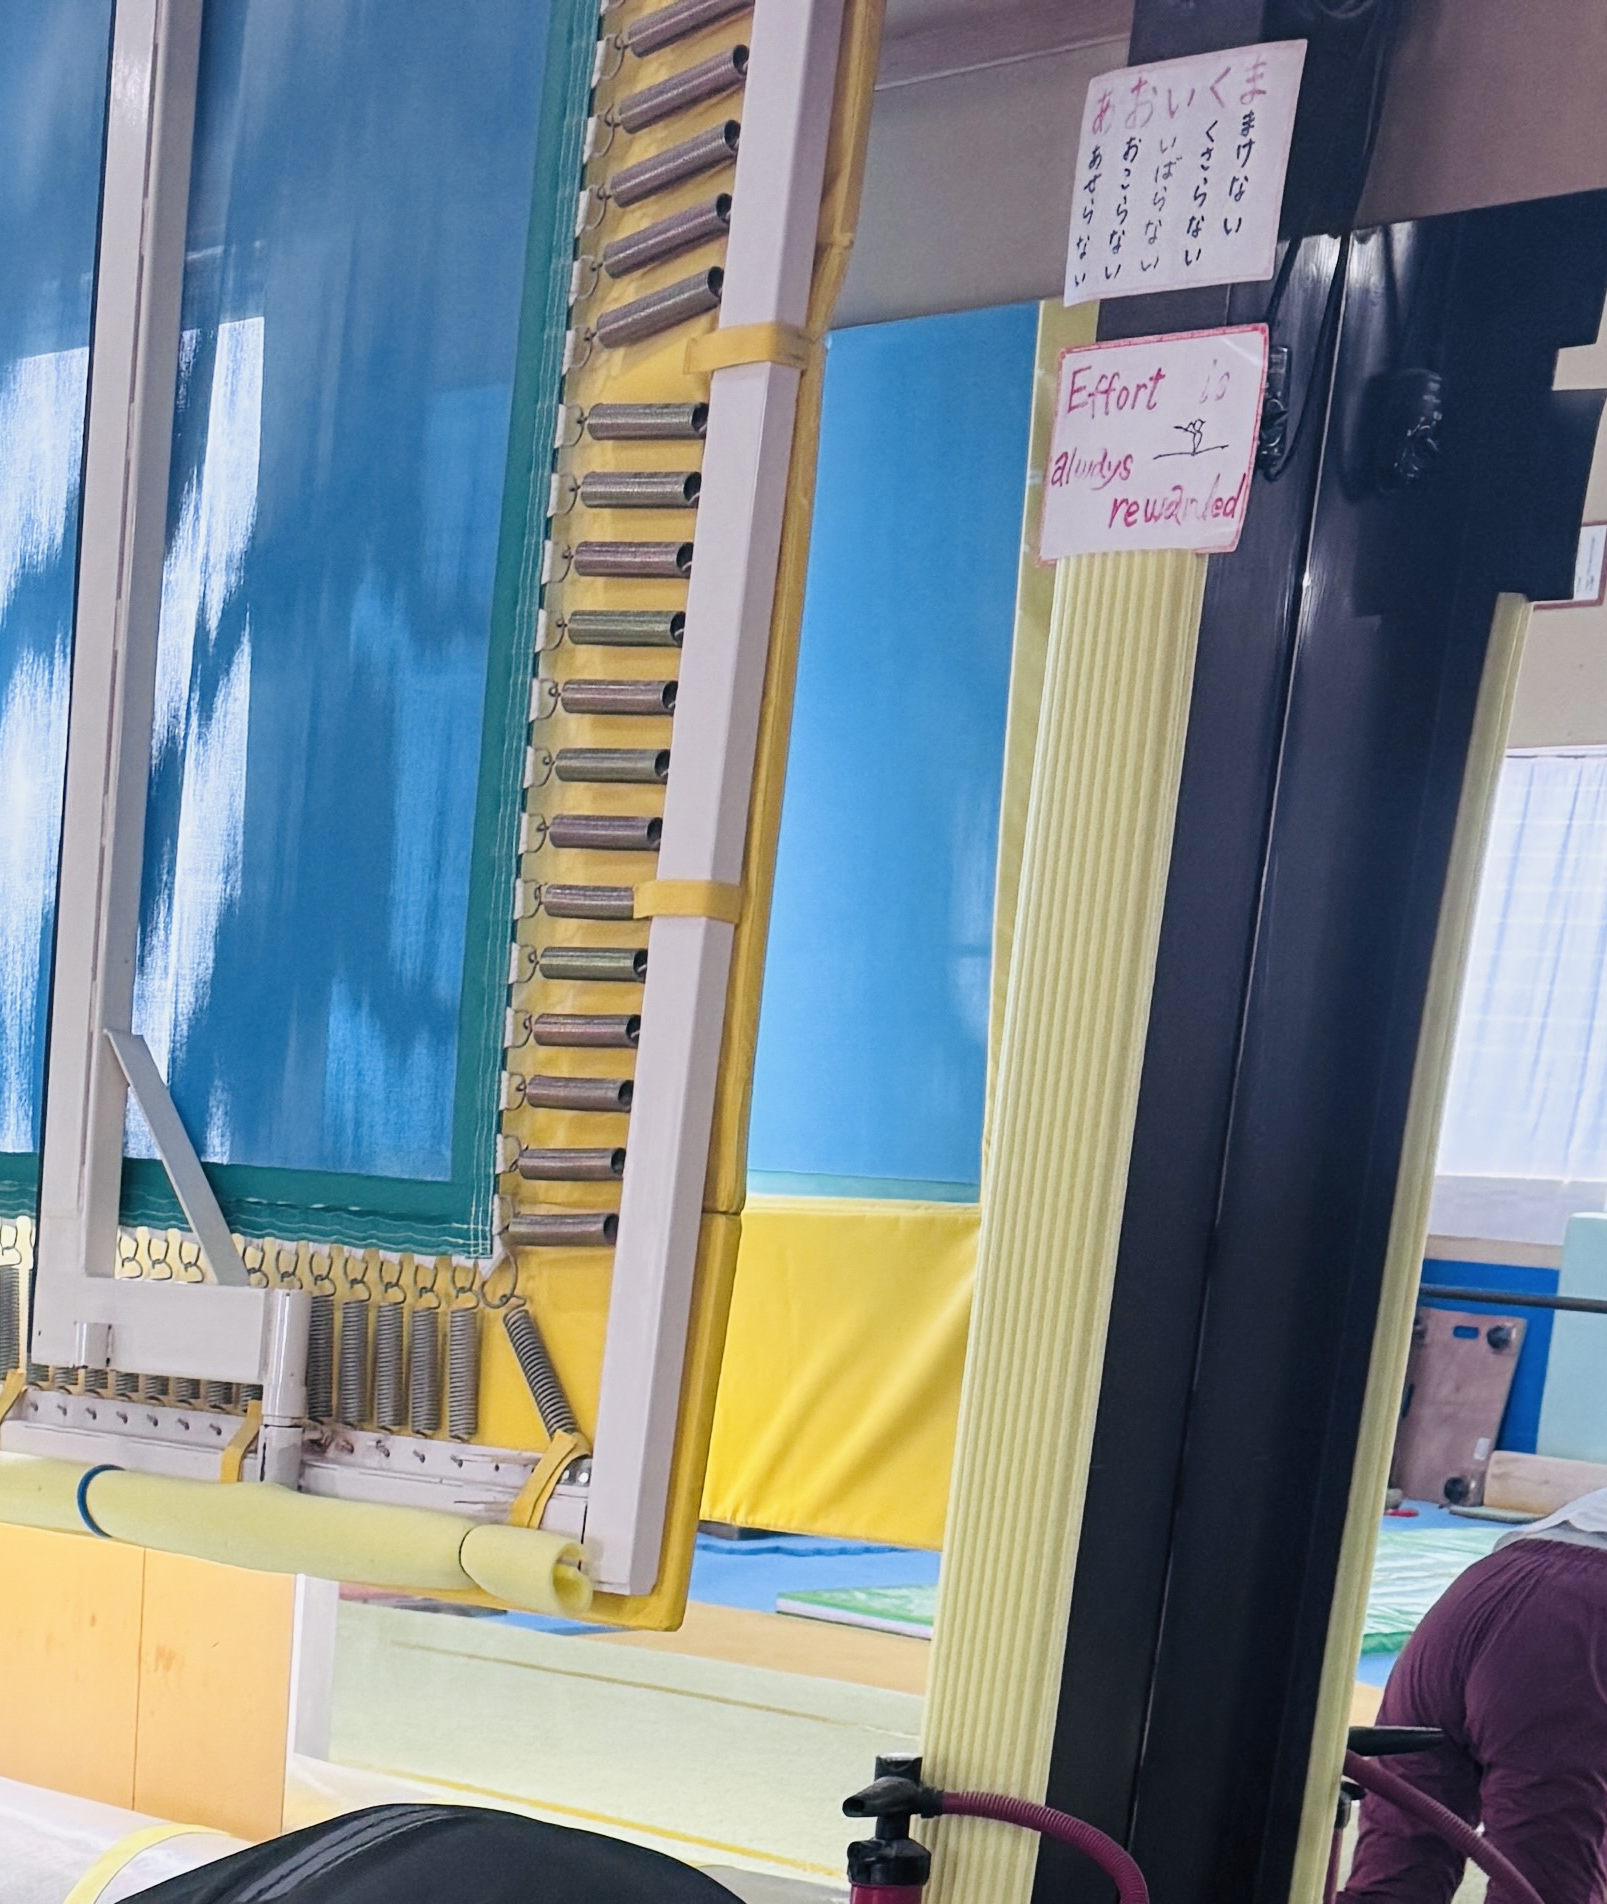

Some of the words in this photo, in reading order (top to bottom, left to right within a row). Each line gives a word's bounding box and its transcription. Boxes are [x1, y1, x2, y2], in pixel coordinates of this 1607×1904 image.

[1092, 54, 1268, 135] あおいくま
[1073, 145, 1103, 287] あせらない
[1104, 136, 1142, 280] おこらない
[1140, 136, 1183, 272] いばらない
[1184, 119, 1219, 267] くさらない
[1223, 110, 1256, 236] まけない
[1066, 364, 1166, 419] Effort
[1198, 358, 1230, 404] is
[1107, 472, 1247, 529] rewarded
